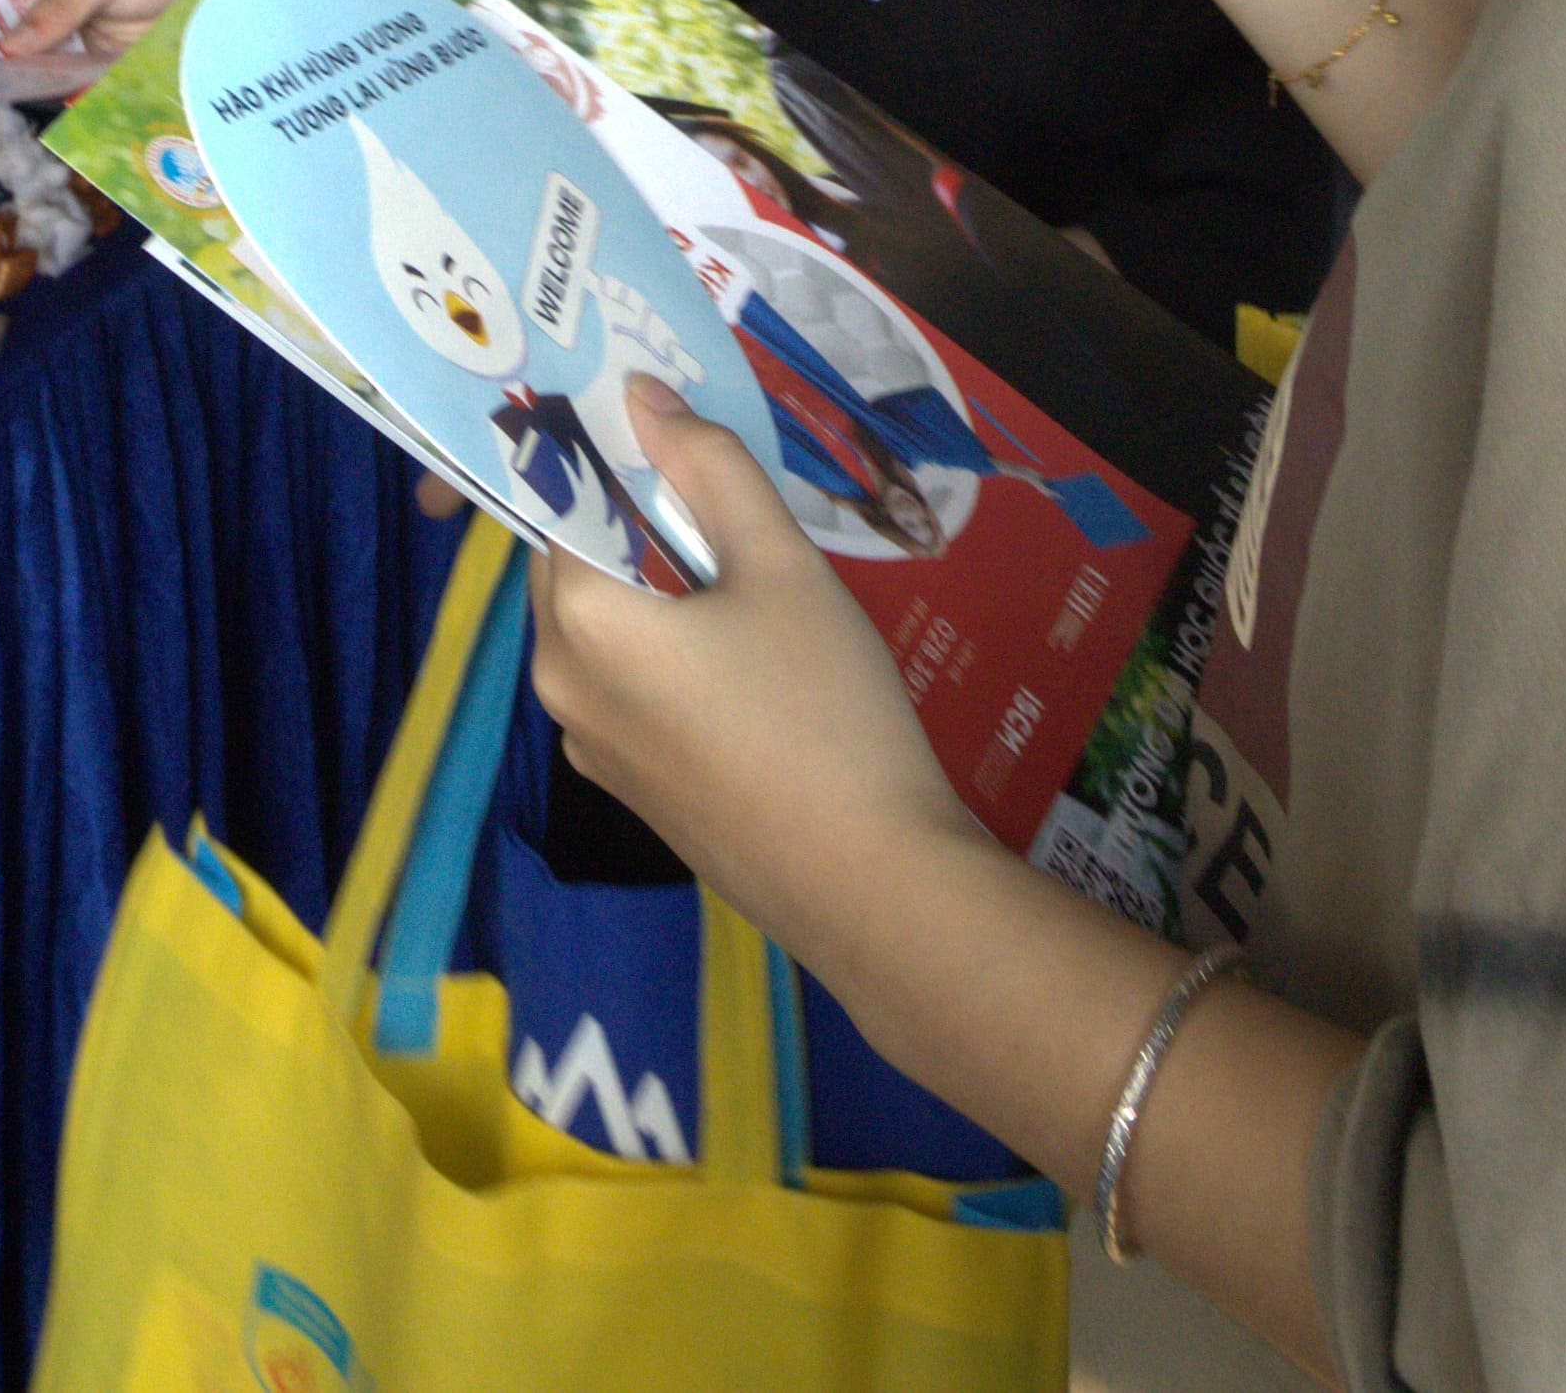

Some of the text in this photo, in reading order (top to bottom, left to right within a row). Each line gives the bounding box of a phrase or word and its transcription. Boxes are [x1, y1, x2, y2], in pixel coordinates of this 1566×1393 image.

[210, 85, 265, 124] HÀO
[256, 61, 306, 103] KHÍ
[298, 41, 361, 85] HÙNG
[341, 77, 387, 110] LAI
[532, 183, 587, 327] WELCOME
